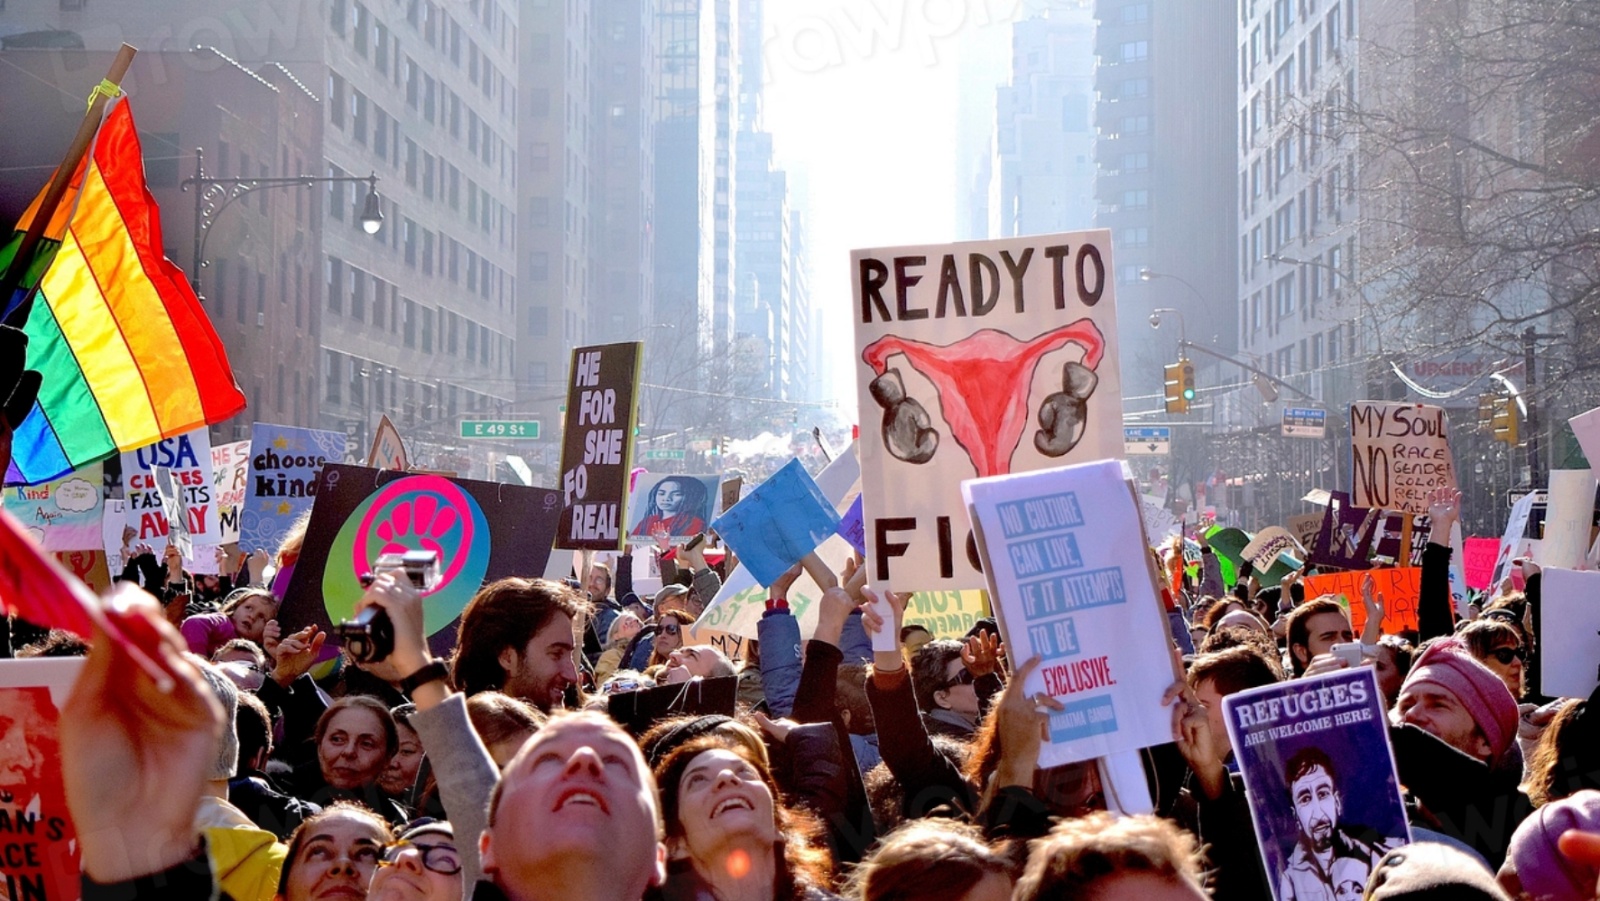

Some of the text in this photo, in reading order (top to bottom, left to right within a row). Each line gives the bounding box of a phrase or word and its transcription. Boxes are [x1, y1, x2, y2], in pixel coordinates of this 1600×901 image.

[860, 243, 1106, 323] READY TO
[576, 351, 602, 387] HE
[579, 388, 617, 426] FOR
[1351, 405, 1387, 438] MY
[475, 424, 526, 436] E 49 St
[584, 429, 623, 465] SHE
[136, 434, 199, 471] USA
[211, 447, 231, 465] HE
[254, 448, 326, 471] choose
[1392, 443, 1445, 460] RACE
[17, 484, 50, 500] Kind
[130, 470, 204, 489] CHES
[564, 464, 588, 508] FO
[1352, 444, 1389, 507] NO
[1394, 475, 1447, 487] COLOR
[130, 486, 210, 509] FASTS
[1000, 494, 1082, 535] NO CULTURE
[139, 505, 209, 540] AWY
[220, 505, 243, 538] M
[571, 503, 619, 540] REAL
[1010, 536, 1082, 576] CAN LIVE,
[1021, 570, 1124, 617] IF IT ATTEMPTS
[1307, 571, 1377, 597] WHO
[1390, 569, 1420, 595] RU
[710, 634, 743, 658] MY
[1030, 620, 1077, 654] TO BE
[1041, 656, 1117, 697] EXCLUSIVE.
[1236, 681, 1368, 729] REFUGEES
[1244, 708, 1372, 747] ARE WELCOME HERE
[0, 842, 41, 869] CE
[6, 872, 47, 901] IN
